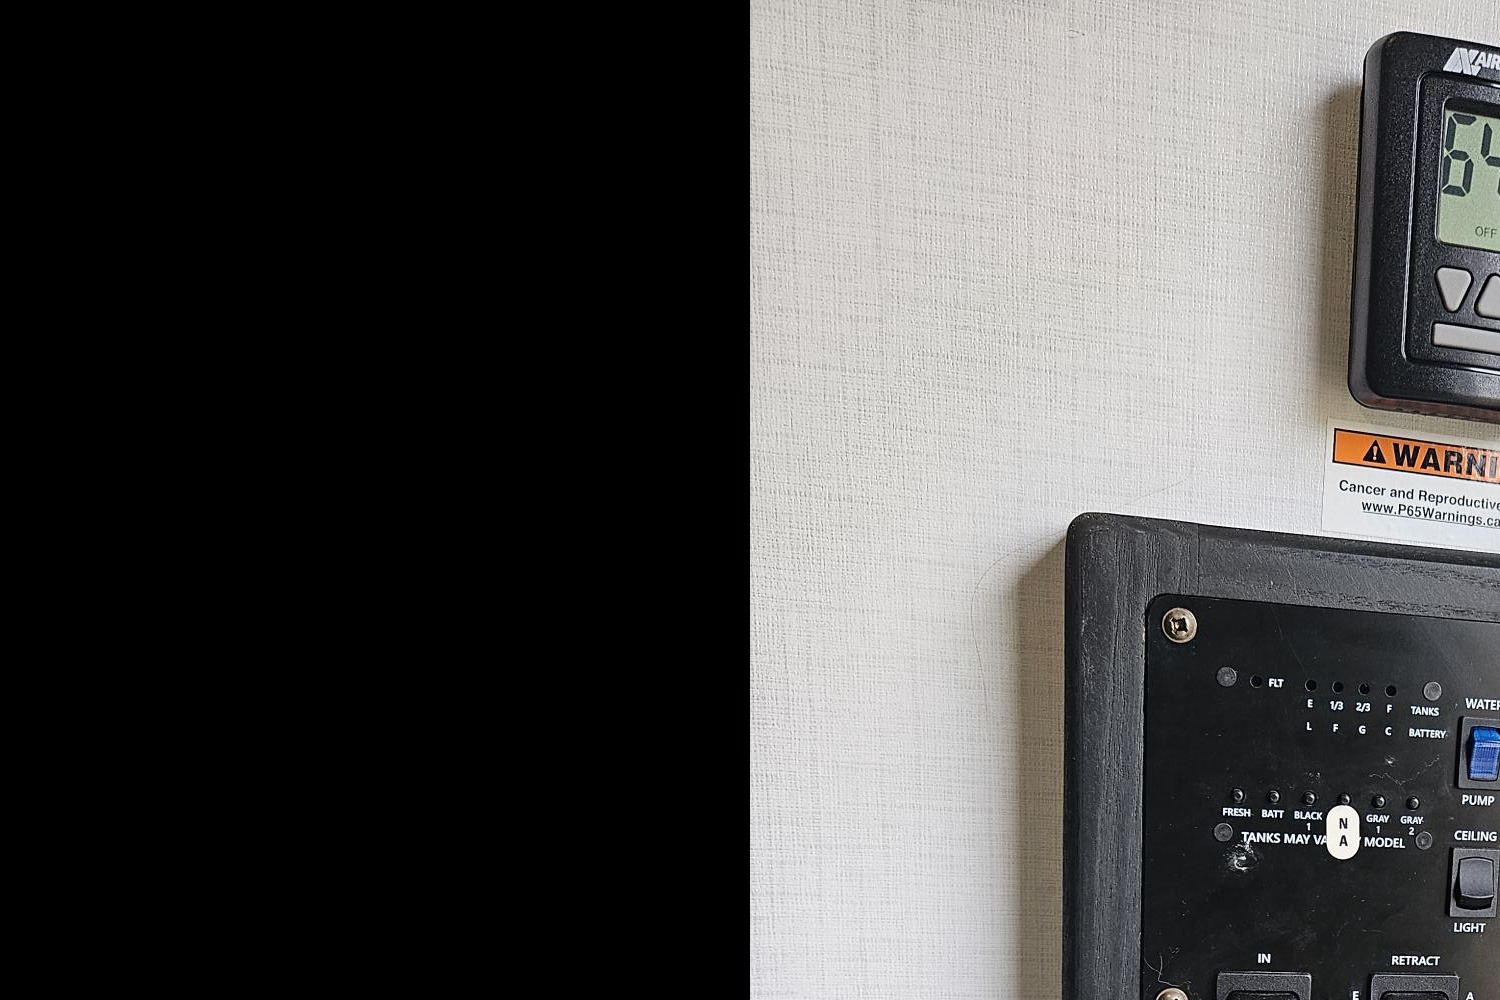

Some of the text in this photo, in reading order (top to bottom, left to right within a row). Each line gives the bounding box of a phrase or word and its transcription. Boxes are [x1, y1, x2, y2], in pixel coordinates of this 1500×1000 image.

[1474, 226, 1497, 239] OFF
[1339, 479, 1386, 496] Cancer
[1390, 488, 1414, 500] and
[1268, 678, 1284, 688] FLT
[1307, 699, 1440, 717] E 1/3 2/3 F TANKS
[1306, 722, 1446, 739] L F G C BATTERY
[1461, 794, 1495, 807] PUMP
[1222, 807, 1250, 818] FRESH
[1261, 809, 1284, 819] BATT
[1294, 810, 1323, 821] BLACK
[1366, 814, 1390, 824] GRAY
[1400, 815, 1423, 825] GRAY
[1306, 822, 1311, 831] 1
[1376, 826, 1381, 834] 1
[1408, 827, 1415, 836] 2
[1241, 831, 1281, 845] TANKS
[1283, 833, 1313, 845] MAY
[1364, 836, 1406, 849] MODEL
[1454, 830, 1498, 842] CEILING
[1453, 922, 1486, 933] LIGHT
[1257, 953, 1272, 964] IN
[1391, 955, 1440, 966] RETRACT
